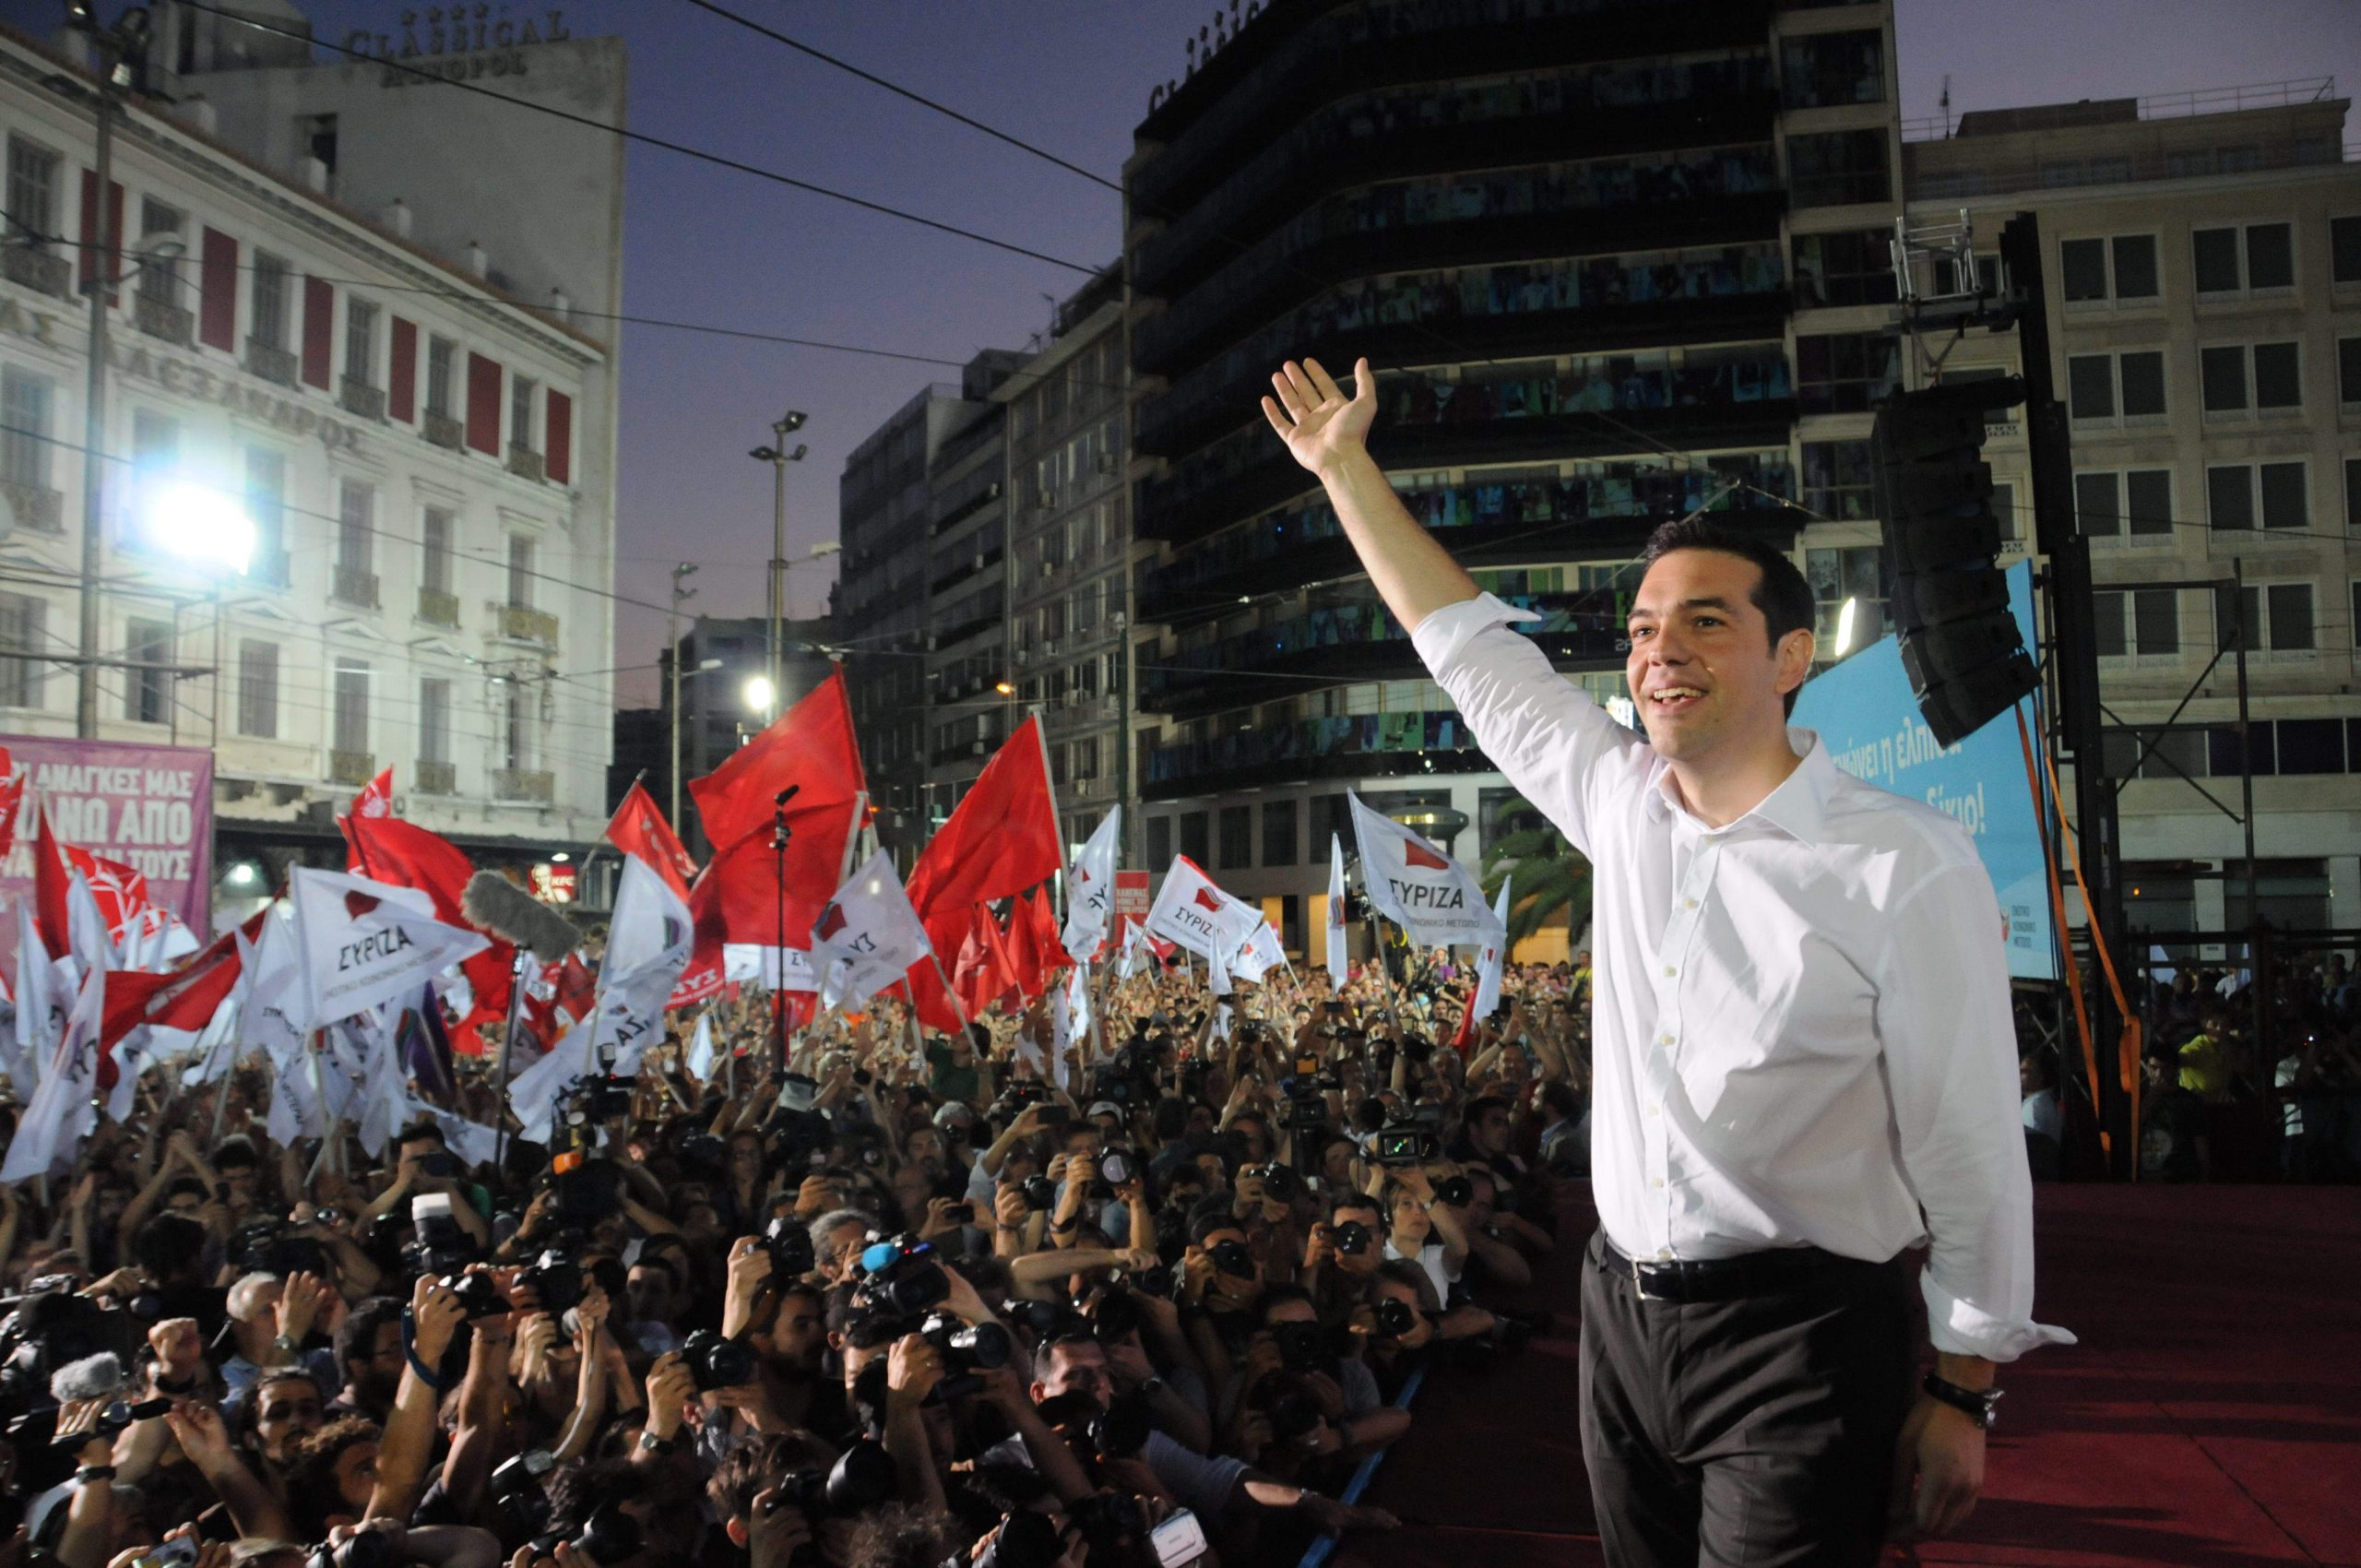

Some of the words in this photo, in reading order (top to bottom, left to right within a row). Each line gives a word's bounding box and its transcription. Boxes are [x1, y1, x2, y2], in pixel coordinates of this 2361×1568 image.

[344, 10, 570, 64] CLASSICAL
[36, 762, 142, 796] ΑΝΑΓΚΕΣ
[144, 768, 193, 799] ΜΑΣ
[1881, 737, 1895, 784] η
[115, 799, 192, 846] ΑΠΟ
[127, 848, 192, 882] ΤΟΥΣ
[1174, 907, 1219, 938] ΣΥΡΙΖ
[338, 924, 415, 972] ΣΥΡΙΖΑ
